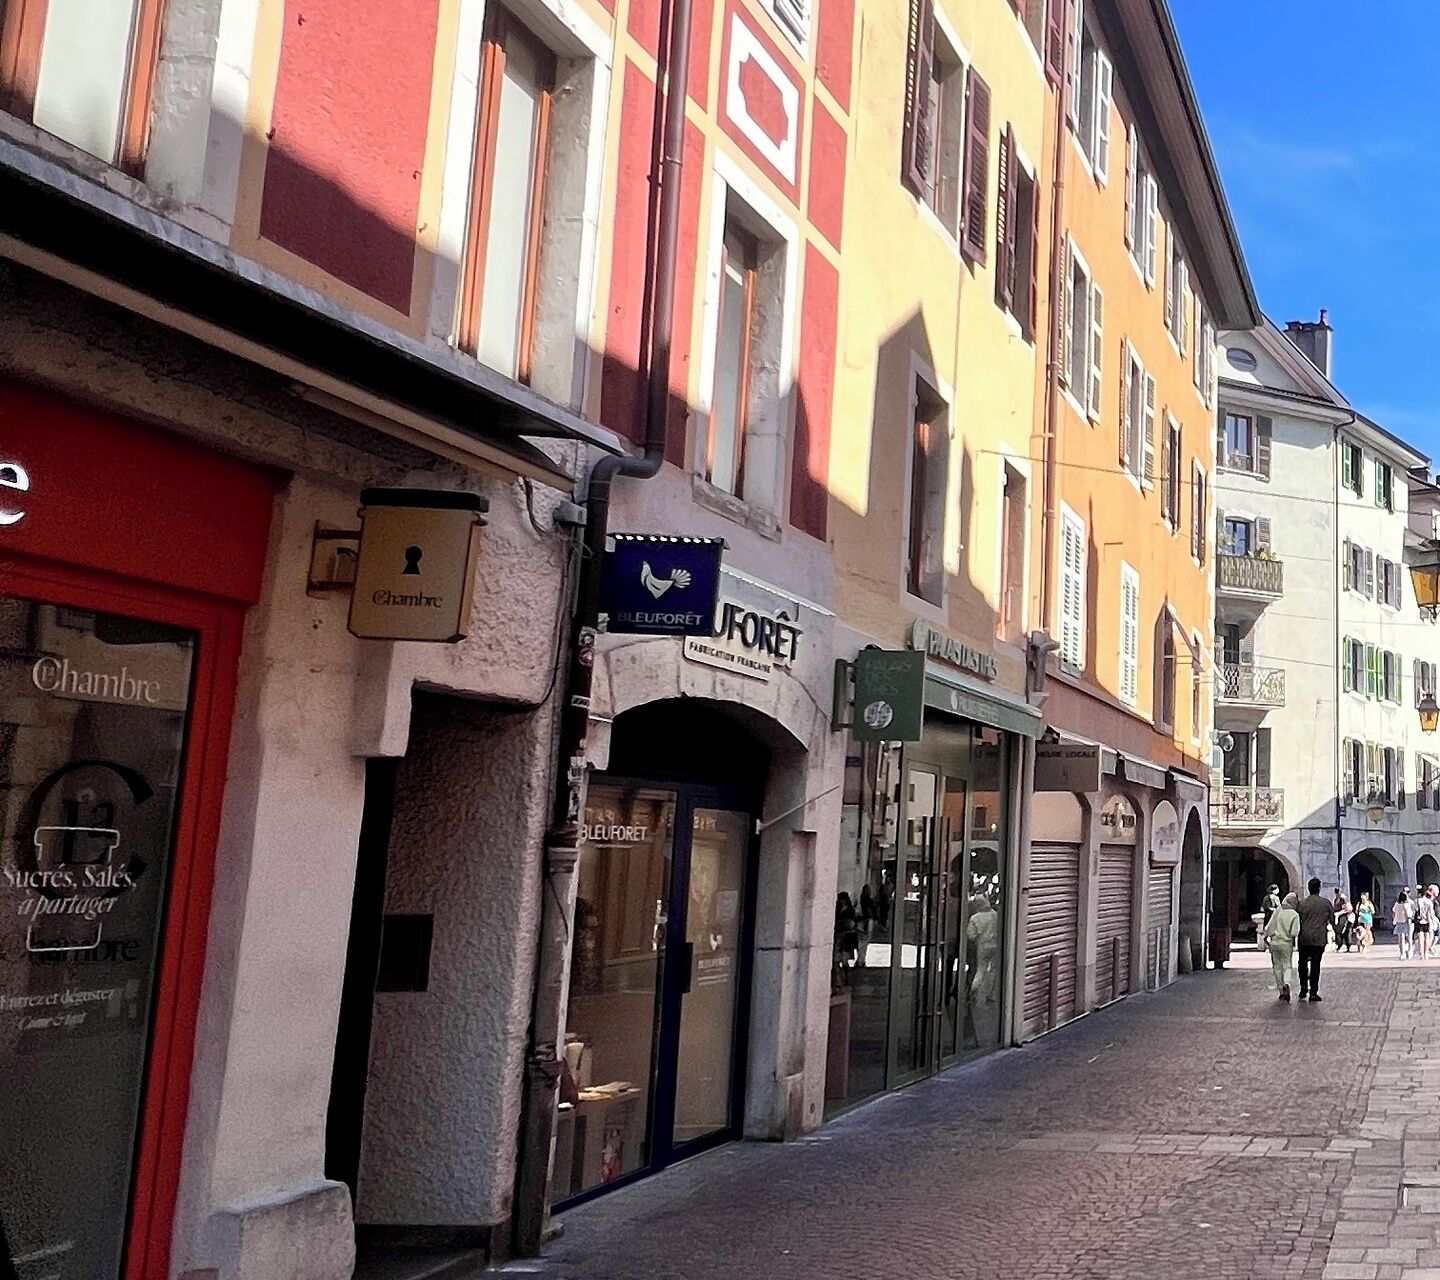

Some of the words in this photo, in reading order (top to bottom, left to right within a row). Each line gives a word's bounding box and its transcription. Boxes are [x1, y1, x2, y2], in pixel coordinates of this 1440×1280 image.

[0, 463, 30, 525] e
[372, 589, 444, 609] Chambre
[617, 611, 704, 626] BLEUFORÊT
[712, 602, 804, 660] UFORÊT
[689, 641, 735, 663] FABRICATION
[32, 656, 161, 703] Chambre
[1065, 750, 1096, 758] LOCALE
[3, 863, 77, 890] Sucrés,
[82, 864, 137, 890] Salés,
[31, 894, 118, 921] partager
